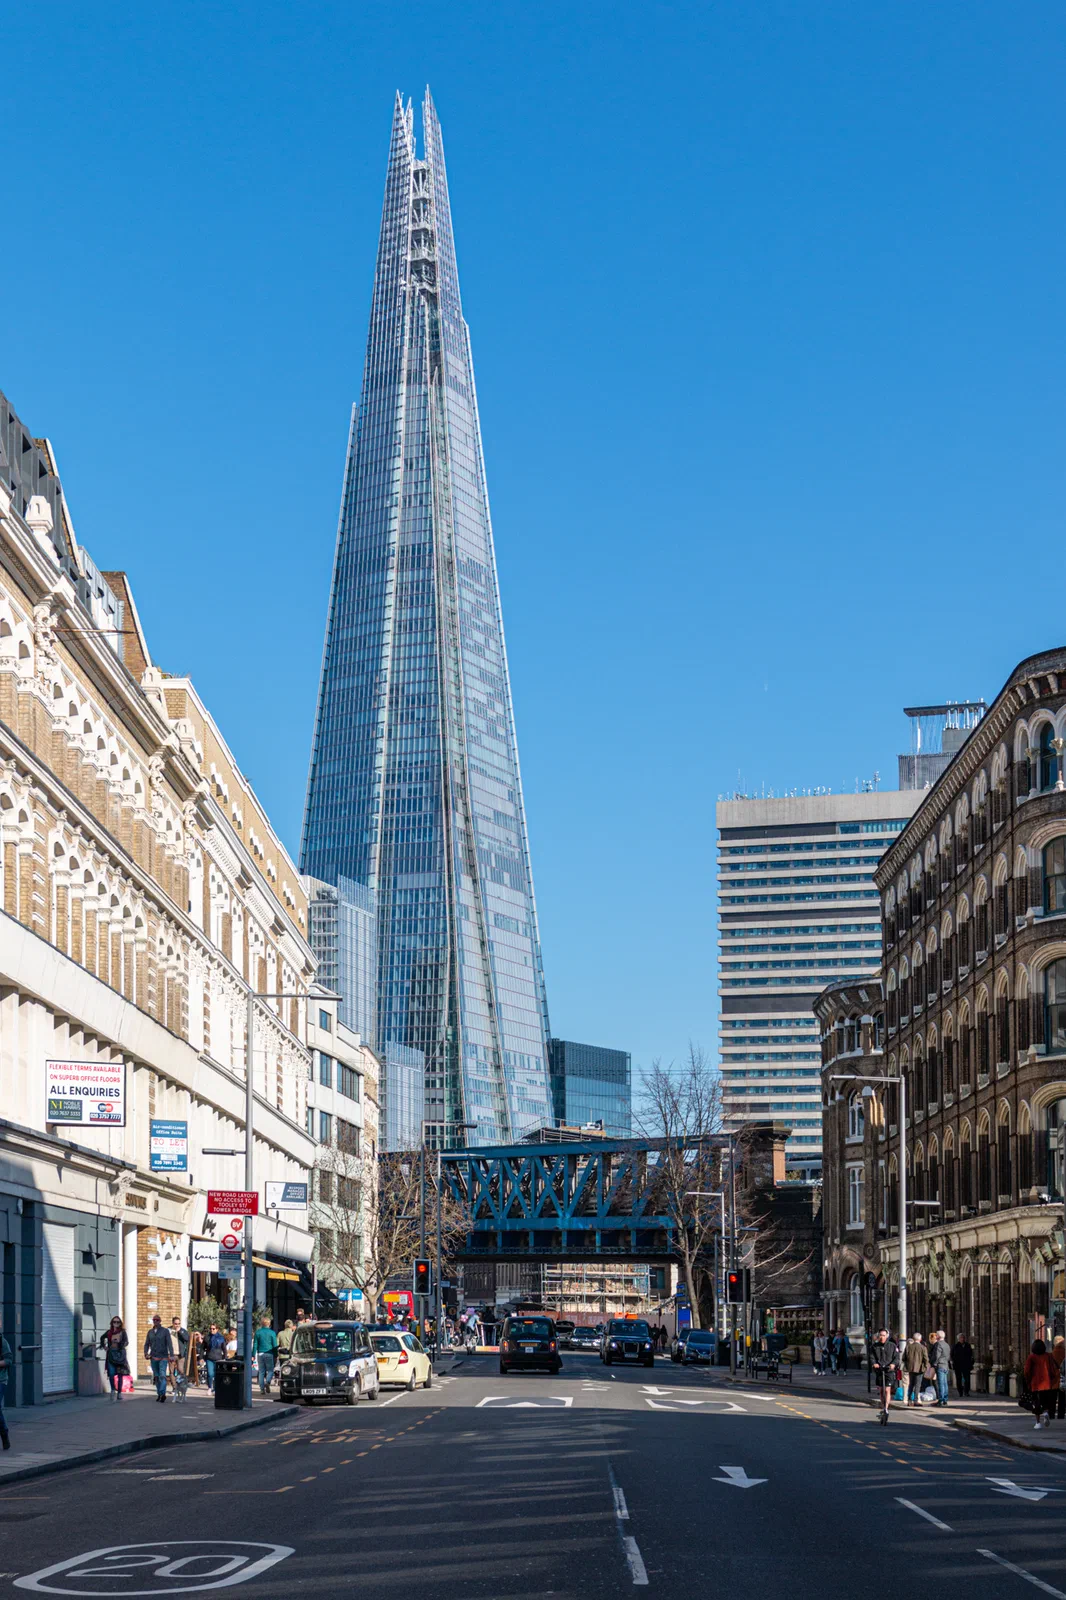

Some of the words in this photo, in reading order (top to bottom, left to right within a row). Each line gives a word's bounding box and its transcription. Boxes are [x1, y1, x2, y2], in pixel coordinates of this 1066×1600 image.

[50, 1085, 67, 1094] ALL
[70, 1086, 120, 1097] ENQUIRIES
[65, 1555, 250, 1578] 20
